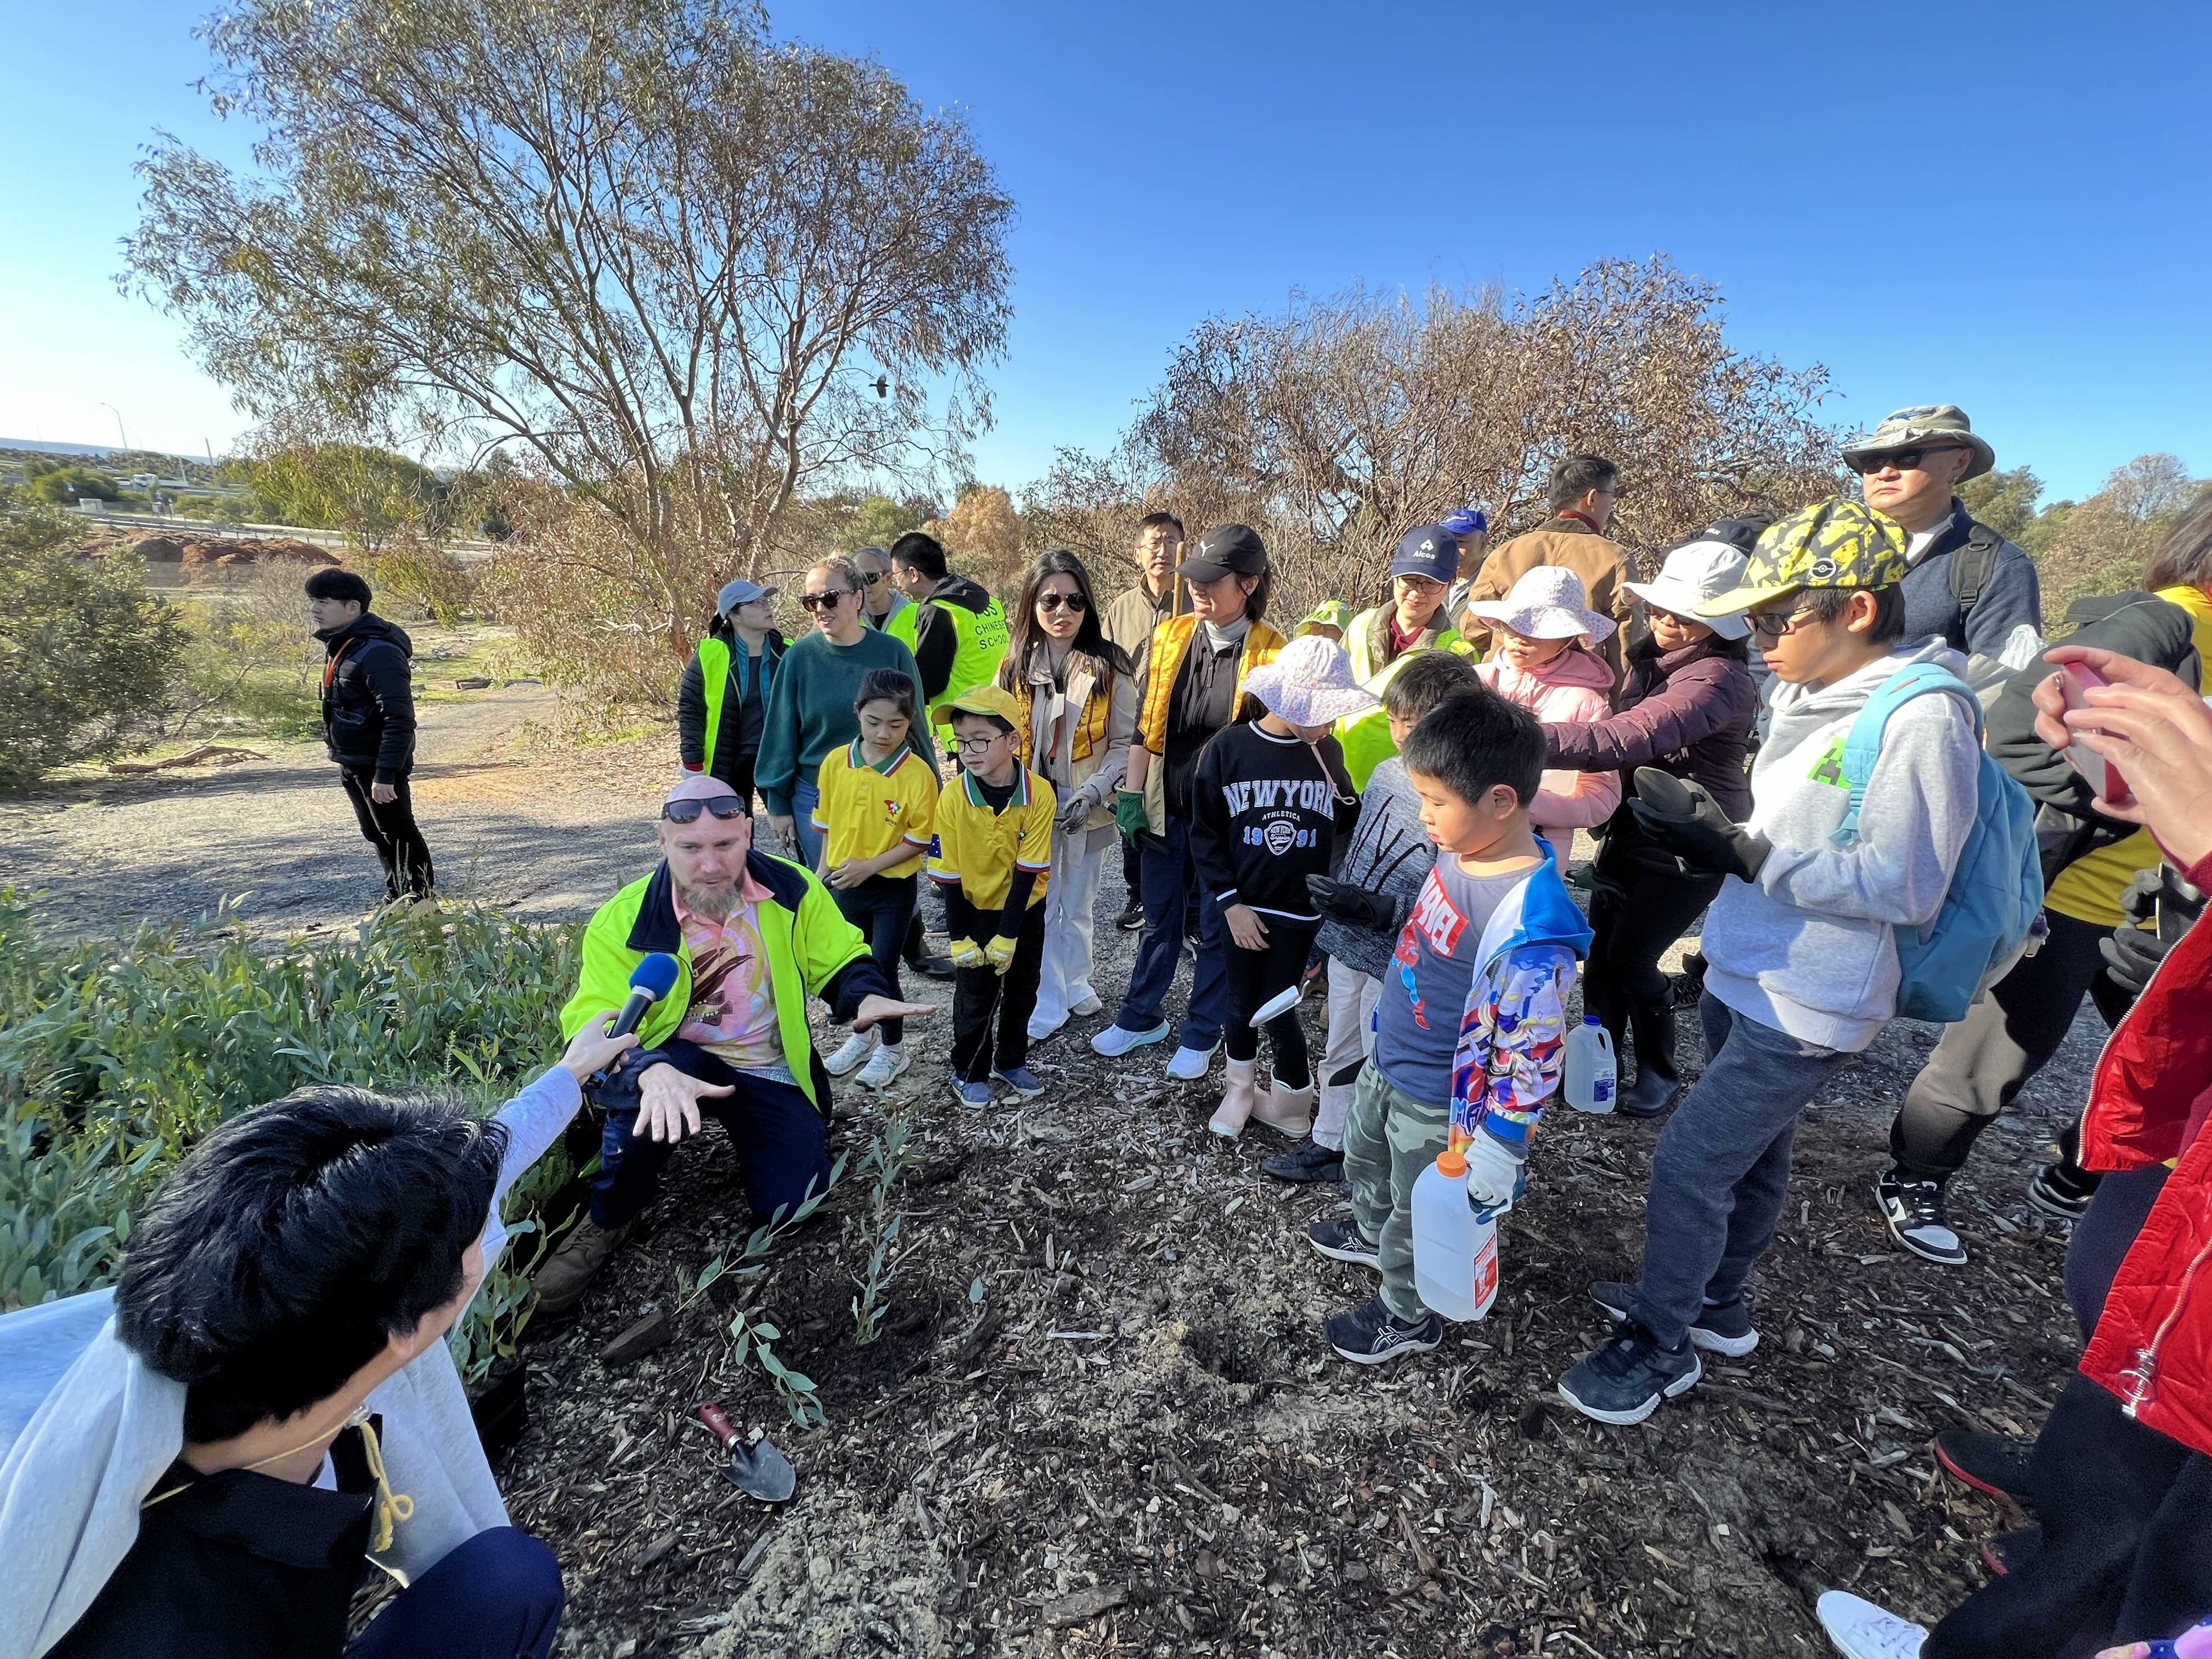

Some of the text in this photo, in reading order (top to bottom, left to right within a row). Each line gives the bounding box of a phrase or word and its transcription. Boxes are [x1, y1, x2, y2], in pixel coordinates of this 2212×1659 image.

[1413, 550, 1435, 560] Alcoa
[975, 620, 1006, 635] CHINESE
[1262, 810, 1300, 821] ATHLETICA
